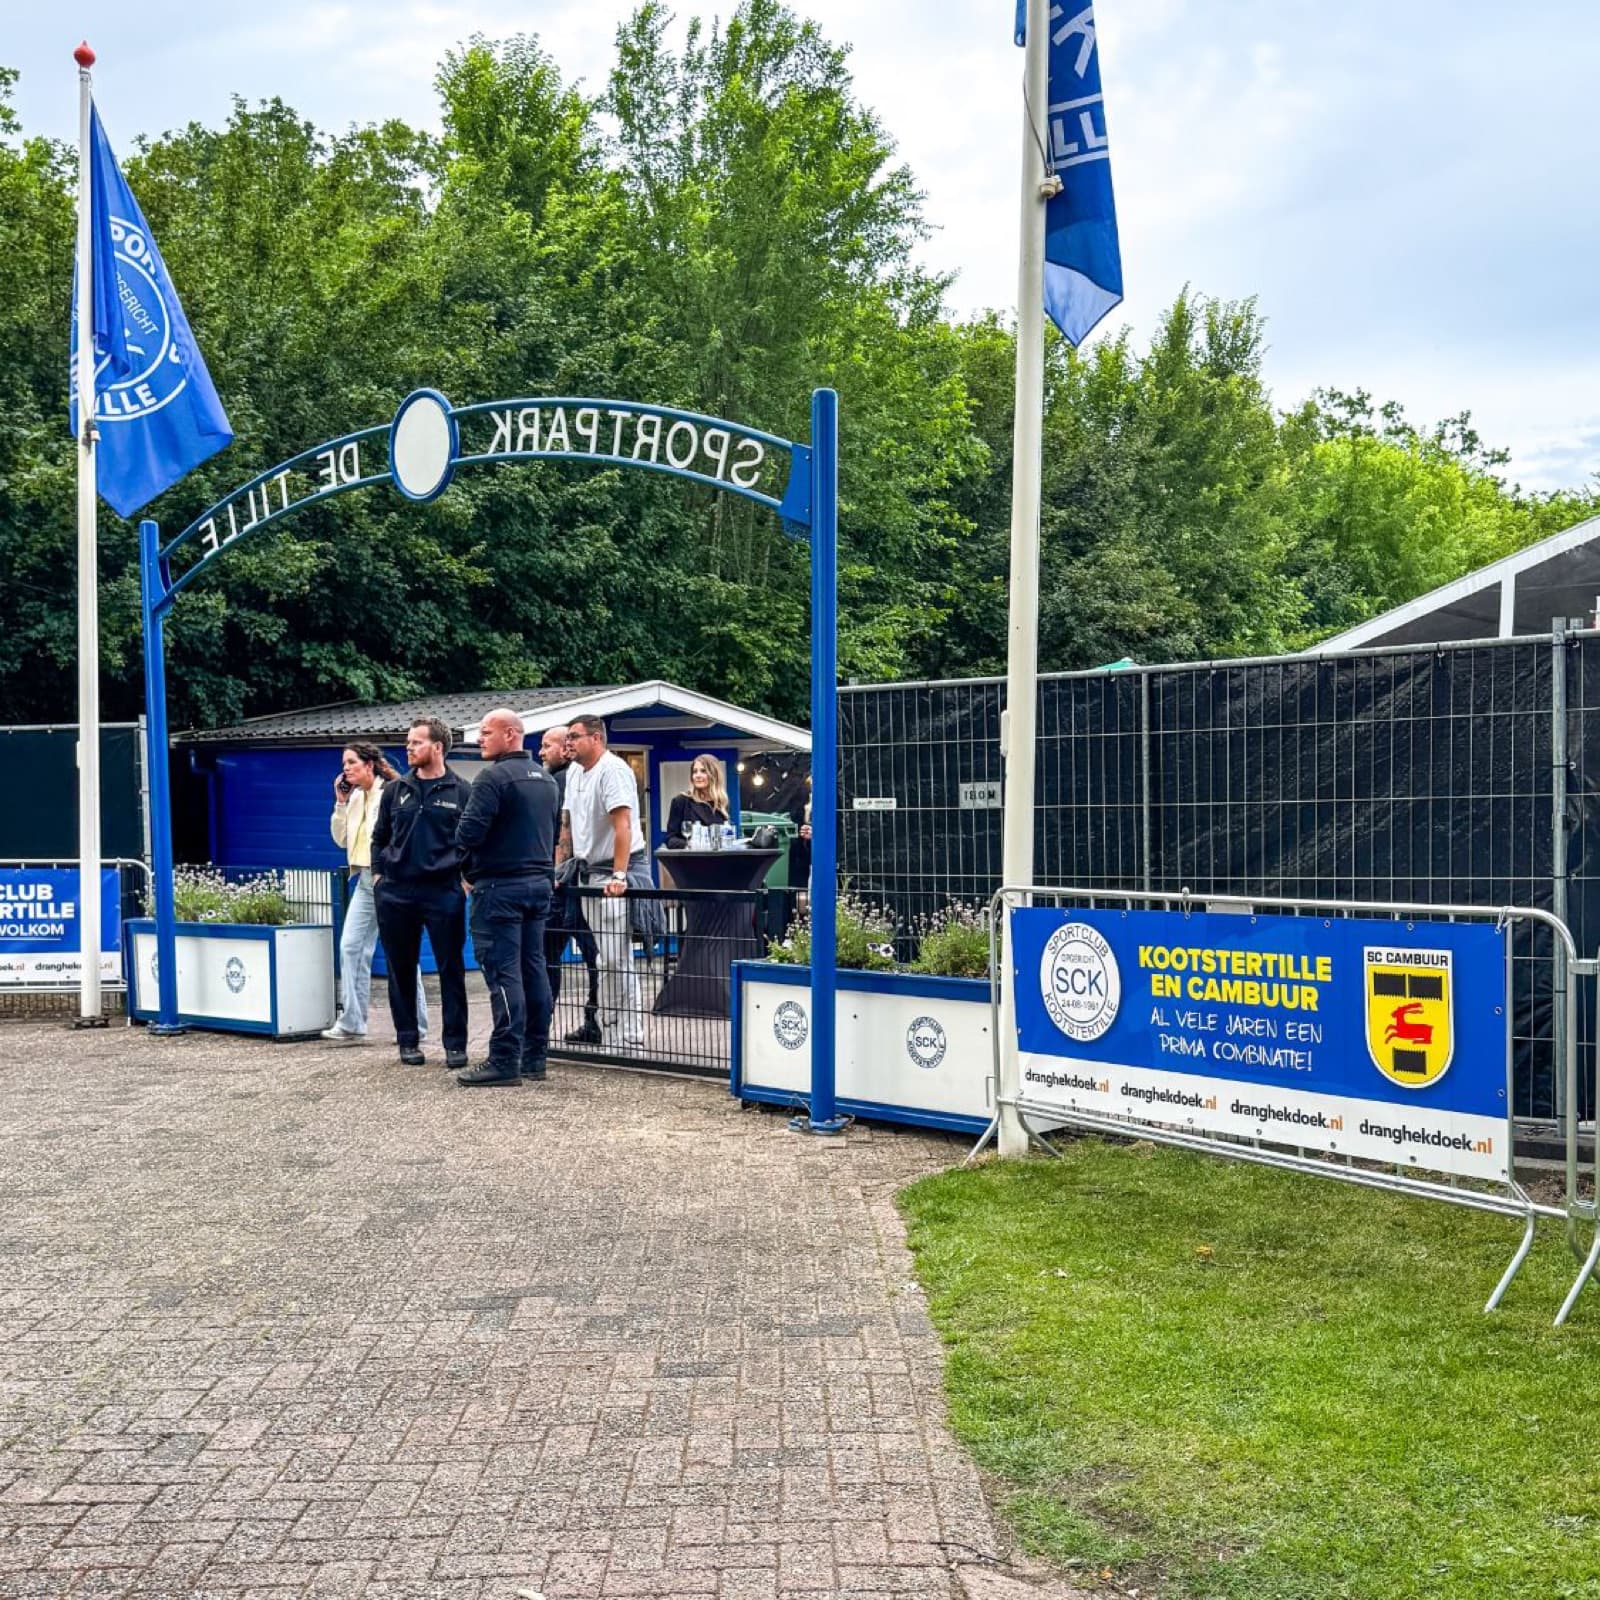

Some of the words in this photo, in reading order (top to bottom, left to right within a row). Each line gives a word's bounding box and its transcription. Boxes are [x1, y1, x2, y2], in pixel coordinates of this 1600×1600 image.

[1138, 945, 1333, 982] KOOTSTERTILLE
[1367, 951, 1383, 962] SC
[1386, 952, 1449, 967] CAMBUUR
[1055, 966, 1104, 997] SCK
[1151, 973, 1181, 998] EN
[1187, 976, 1319, 1012] CAMBUUR
[915, 1036, 937, 1048] SCK
[1150, 1006, 1171, 1026] AL
[1175, 1009, 1218, 1031] VELE
[1225, 1014, 1277, 1039] JAREN
[1285, 1021, 1323, 1044] EEN
[1159, 1033, 1206, 1058] PRIMA
[1212, 1040, 1313, 1072] COMBINATIE!
[1025, 1069, 1109, 1093] dranghekdoek.nl
[1121, 1082, 1217, 1111] dranghekdoek.nl
[1231, 1099, 1343, 1131] dranghekdoek.nl
[1359, 1119, 1492, 1155] dranghekdoek.nl
